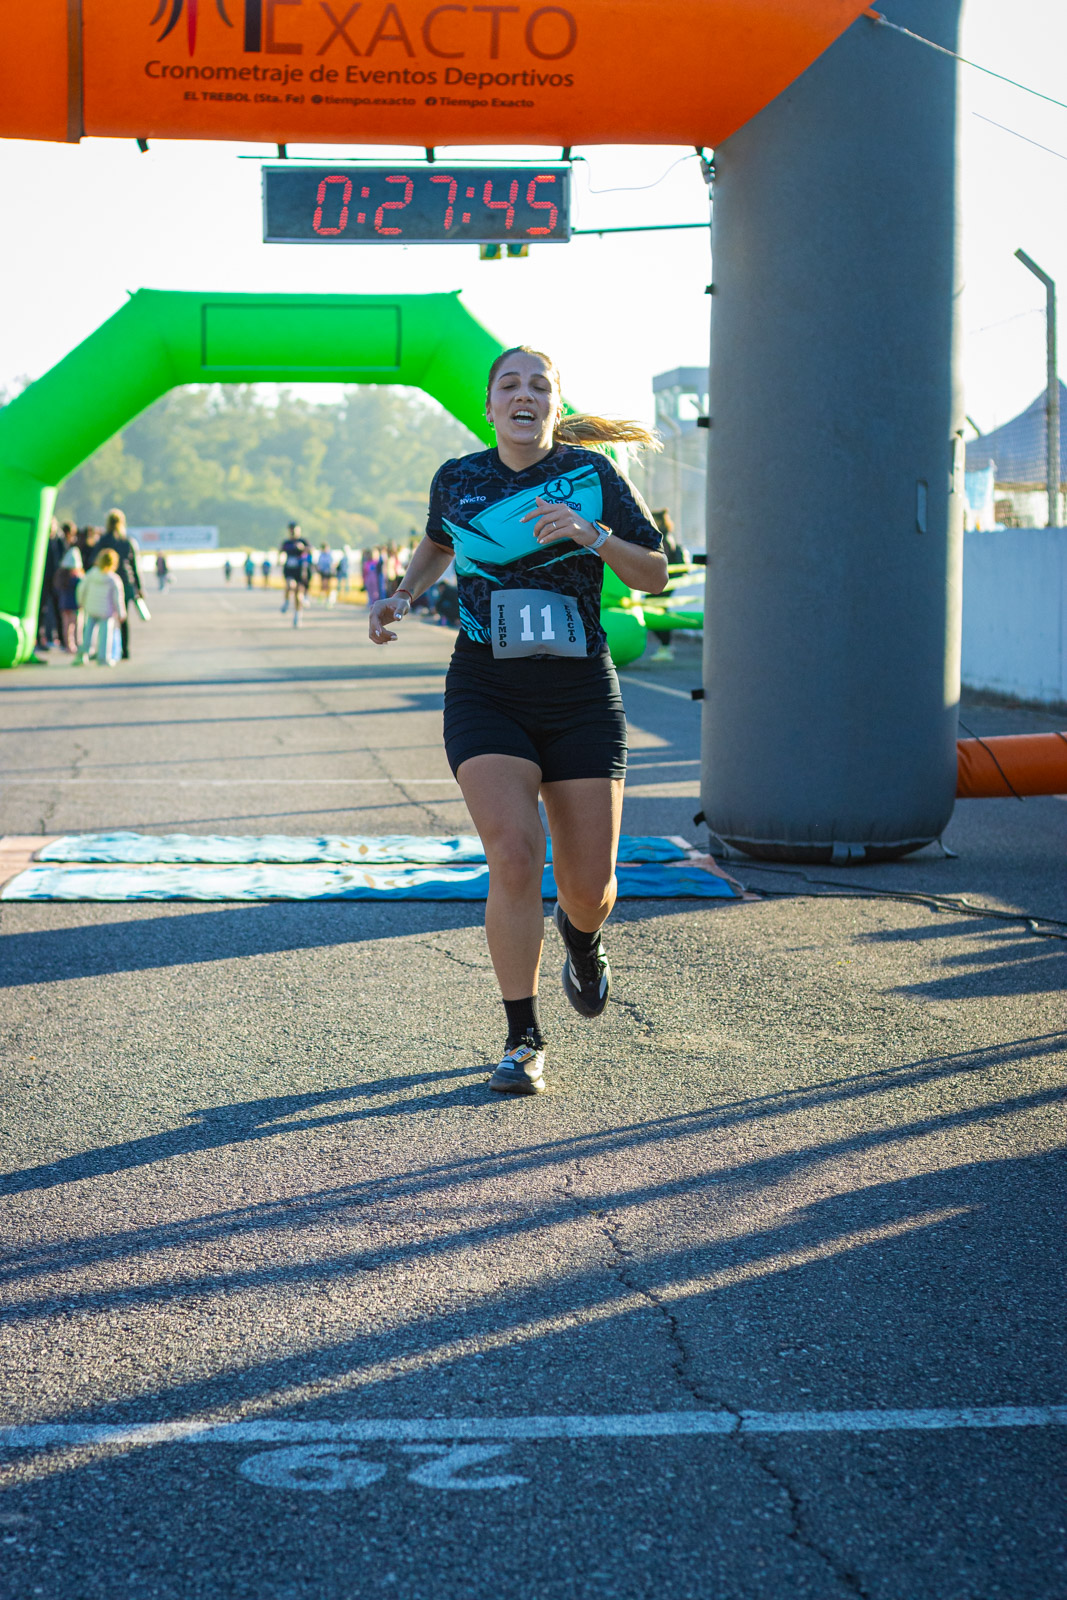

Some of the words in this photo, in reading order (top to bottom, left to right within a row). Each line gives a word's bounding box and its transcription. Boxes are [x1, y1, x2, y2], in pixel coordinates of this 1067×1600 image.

[144, 60, 304, 86] Cronometraje
[309, 64, 339, 83] de
[345, 65, 438, 85] Eventos
[444, 67, 574, 89] Deportivos
[183, 91, 199, 101] EL
[201, 91, 251, 102] TREBOL
[285, 94, 305, 104] Fe)
[440, 97, 488, 108] Tiempo
[491, 98, 535, 108] Exacto
[312, 174, 559, 236] 0:27:45
[497, 604, 508, 647] TIEMPO
[520, 604, 556, 641] 11
